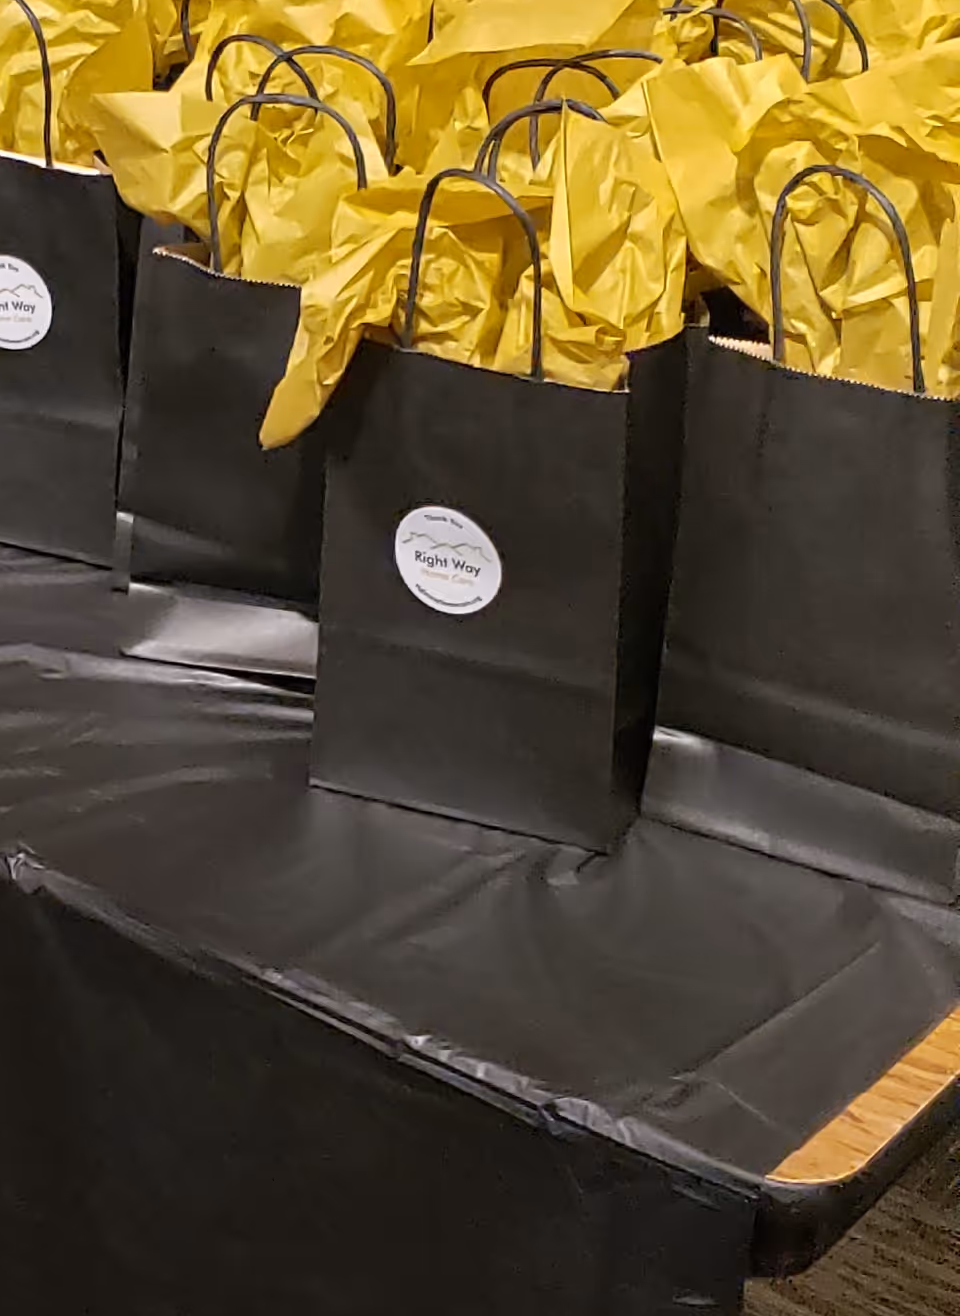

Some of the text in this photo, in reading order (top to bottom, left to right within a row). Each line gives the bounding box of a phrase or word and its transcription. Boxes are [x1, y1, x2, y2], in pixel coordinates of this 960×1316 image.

[11, 300, 36, 315] Way
[414, 549, 482, 579] Right Way
